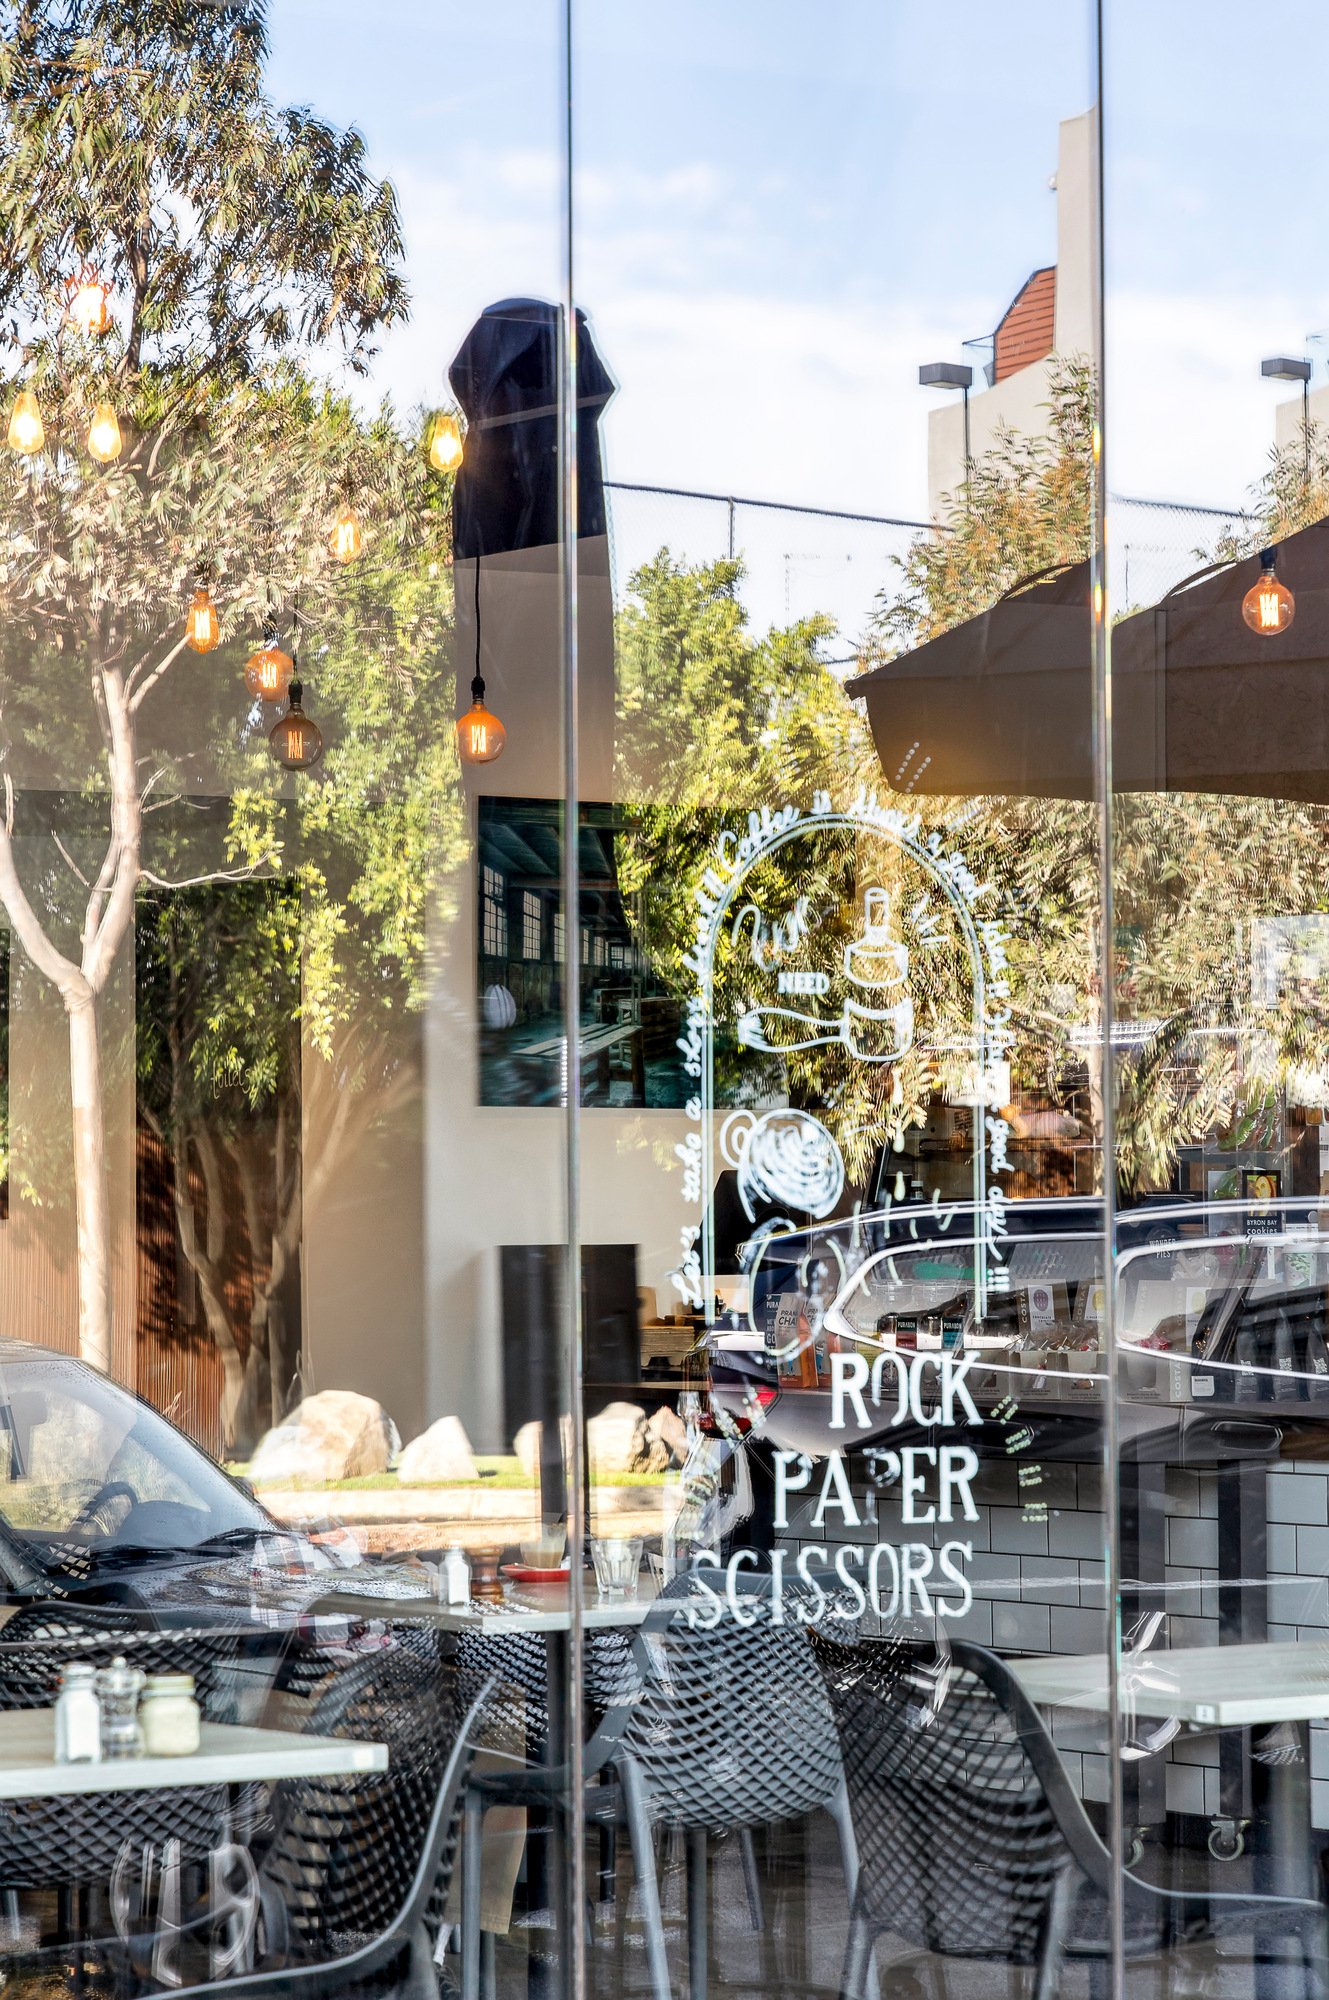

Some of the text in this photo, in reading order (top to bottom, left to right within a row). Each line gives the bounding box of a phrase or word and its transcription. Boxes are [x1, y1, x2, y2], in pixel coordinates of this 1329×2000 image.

[777, 972, 830, 994] NEED
[684, 1095, 702, 1121] a
[673, 1132, 702, 1204] take
[985, 1116, 1015, 1174] good
[1246, 1226, 1278, 1235] cookies
[669, 1225, 704, 1309] Let's
[778, 1316, 796, 1326] CHA
[829, 1350, 984, 1429] ROCK
[772, 1446, 980, 1528] PAPER
[688, 1541, 973, 1630] SCISSORS
